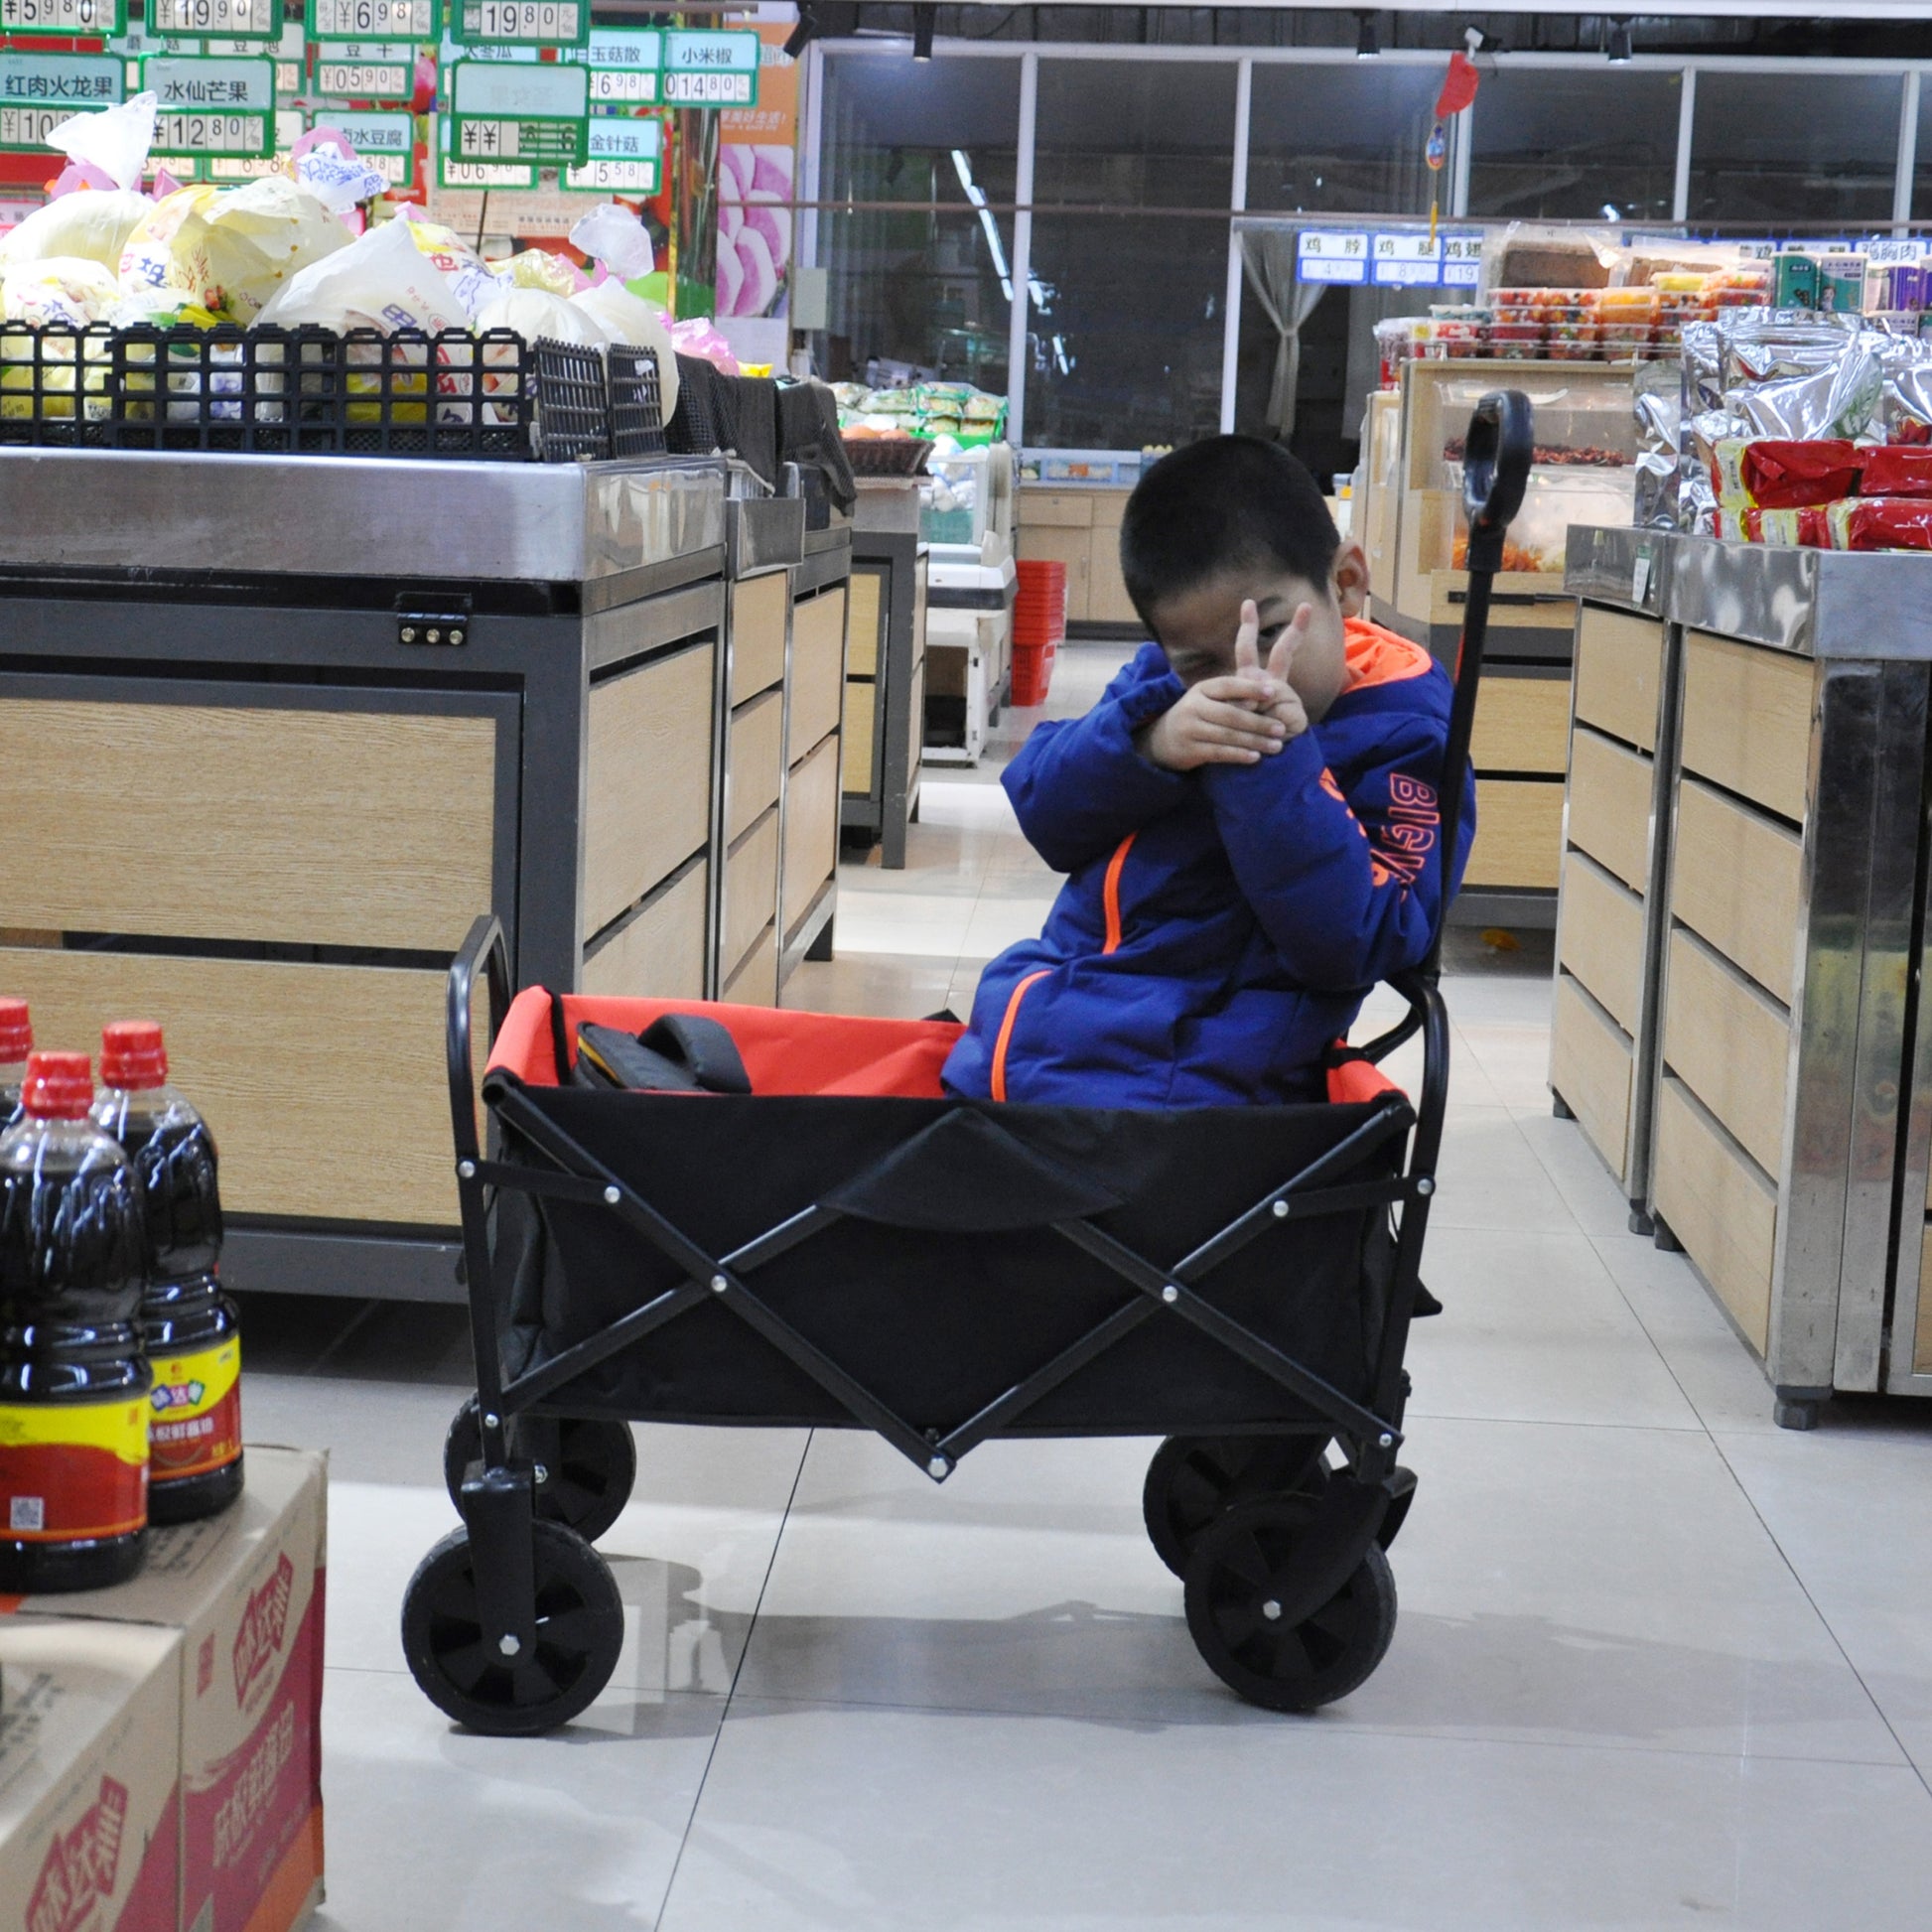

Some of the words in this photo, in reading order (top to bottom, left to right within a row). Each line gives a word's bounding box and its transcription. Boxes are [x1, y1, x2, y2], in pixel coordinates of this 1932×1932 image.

[682, 47, 733, 65] 小米椒
[5, 73, 112, 97] 红肉火龙果
[164, 80, 247, 101] 水仙芒果
[590, 133, 638, 153] 金针菇
